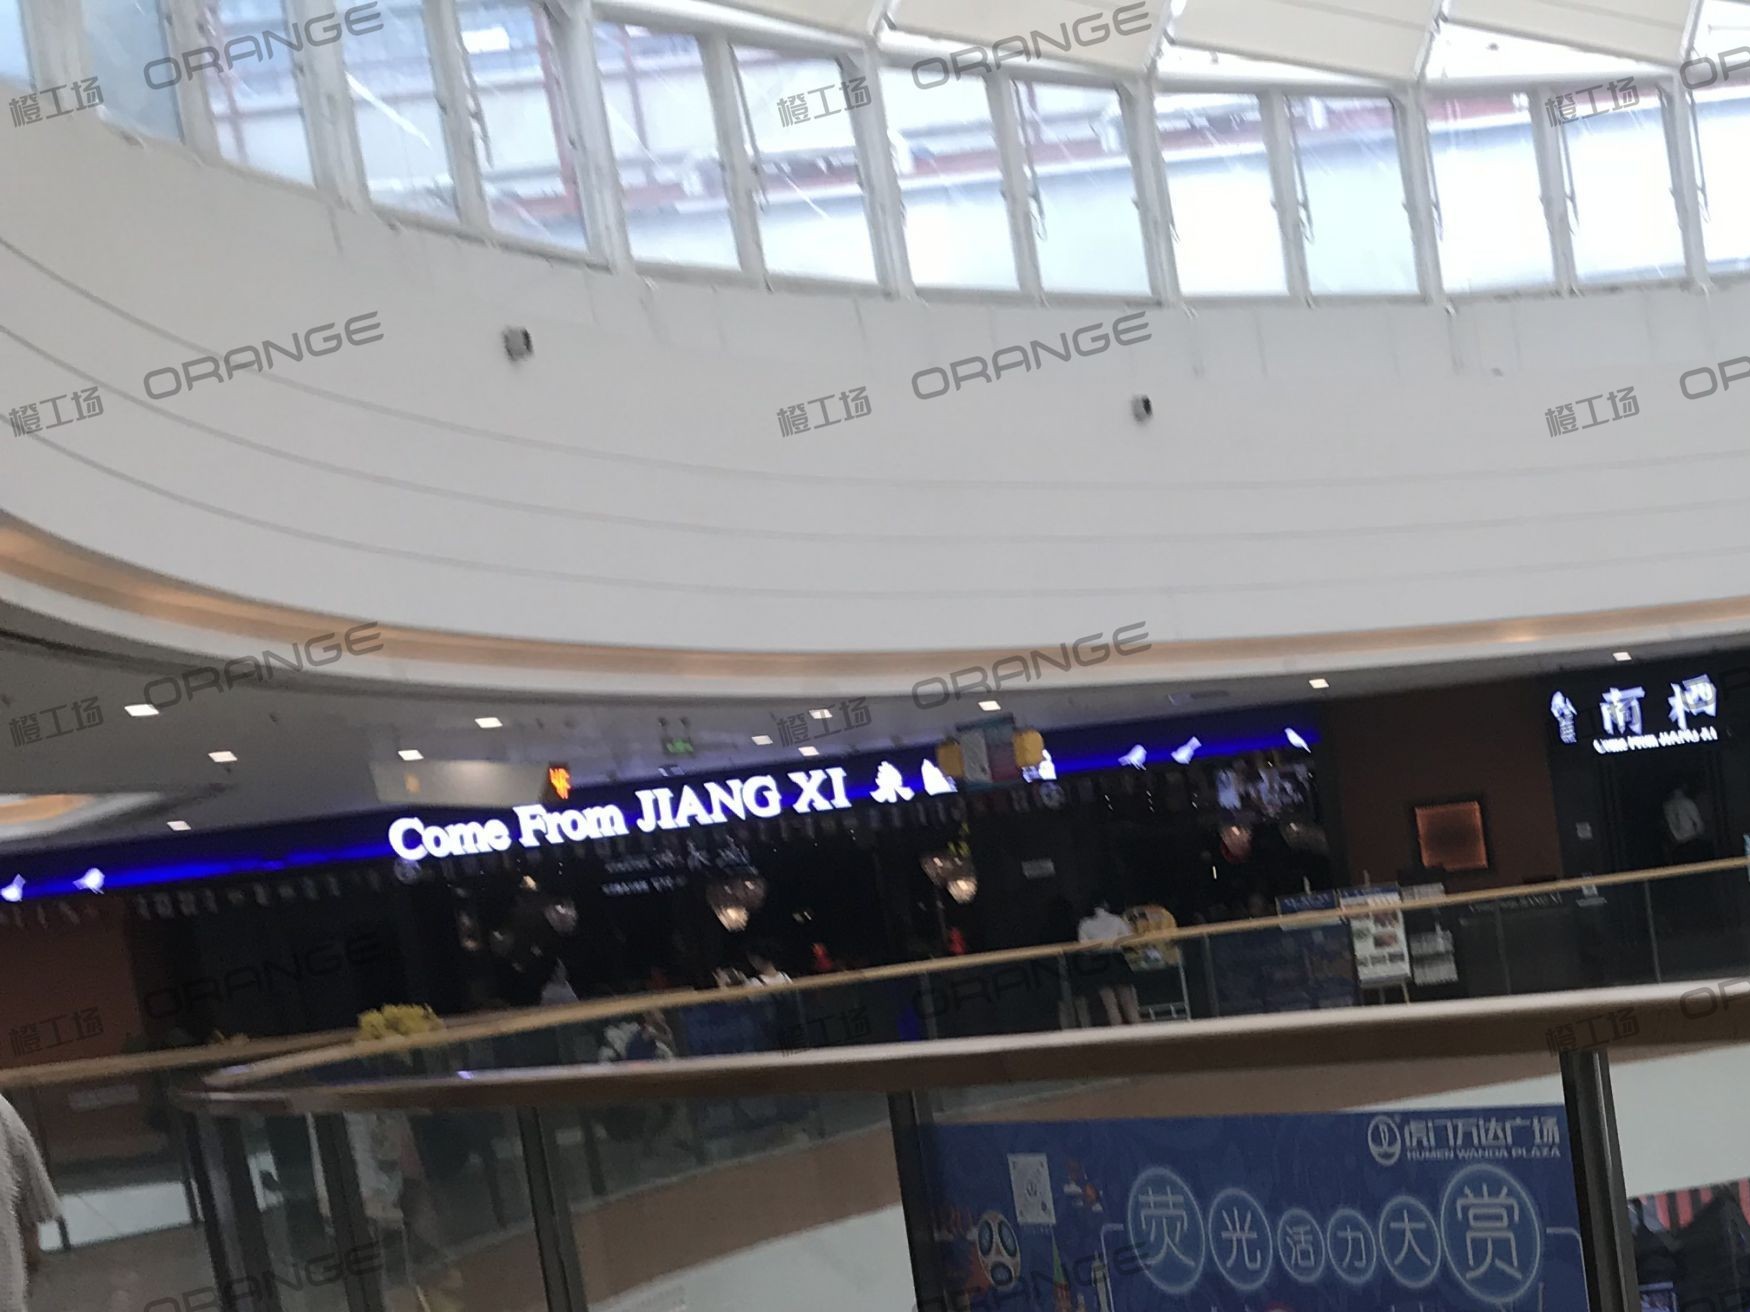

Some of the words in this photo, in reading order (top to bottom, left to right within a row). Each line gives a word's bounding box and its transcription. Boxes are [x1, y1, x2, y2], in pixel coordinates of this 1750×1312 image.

[387, 816, 512, 861] Come
[512, 802, 630, 847] From
[634, 773, 783, 834] JIANG
[787, 766, 853, 814] XI
[1403, 1115, 1562, 1148] 虎门万达广场
[1406, 1148, 1456, 1162] HUMEN
[1457, 1147, 1509, 1161] WANDA
[1511, 1145, 1562, 1160] PLAZA
[1137, 1182, 1522, 1283] 荧光活力大赏
